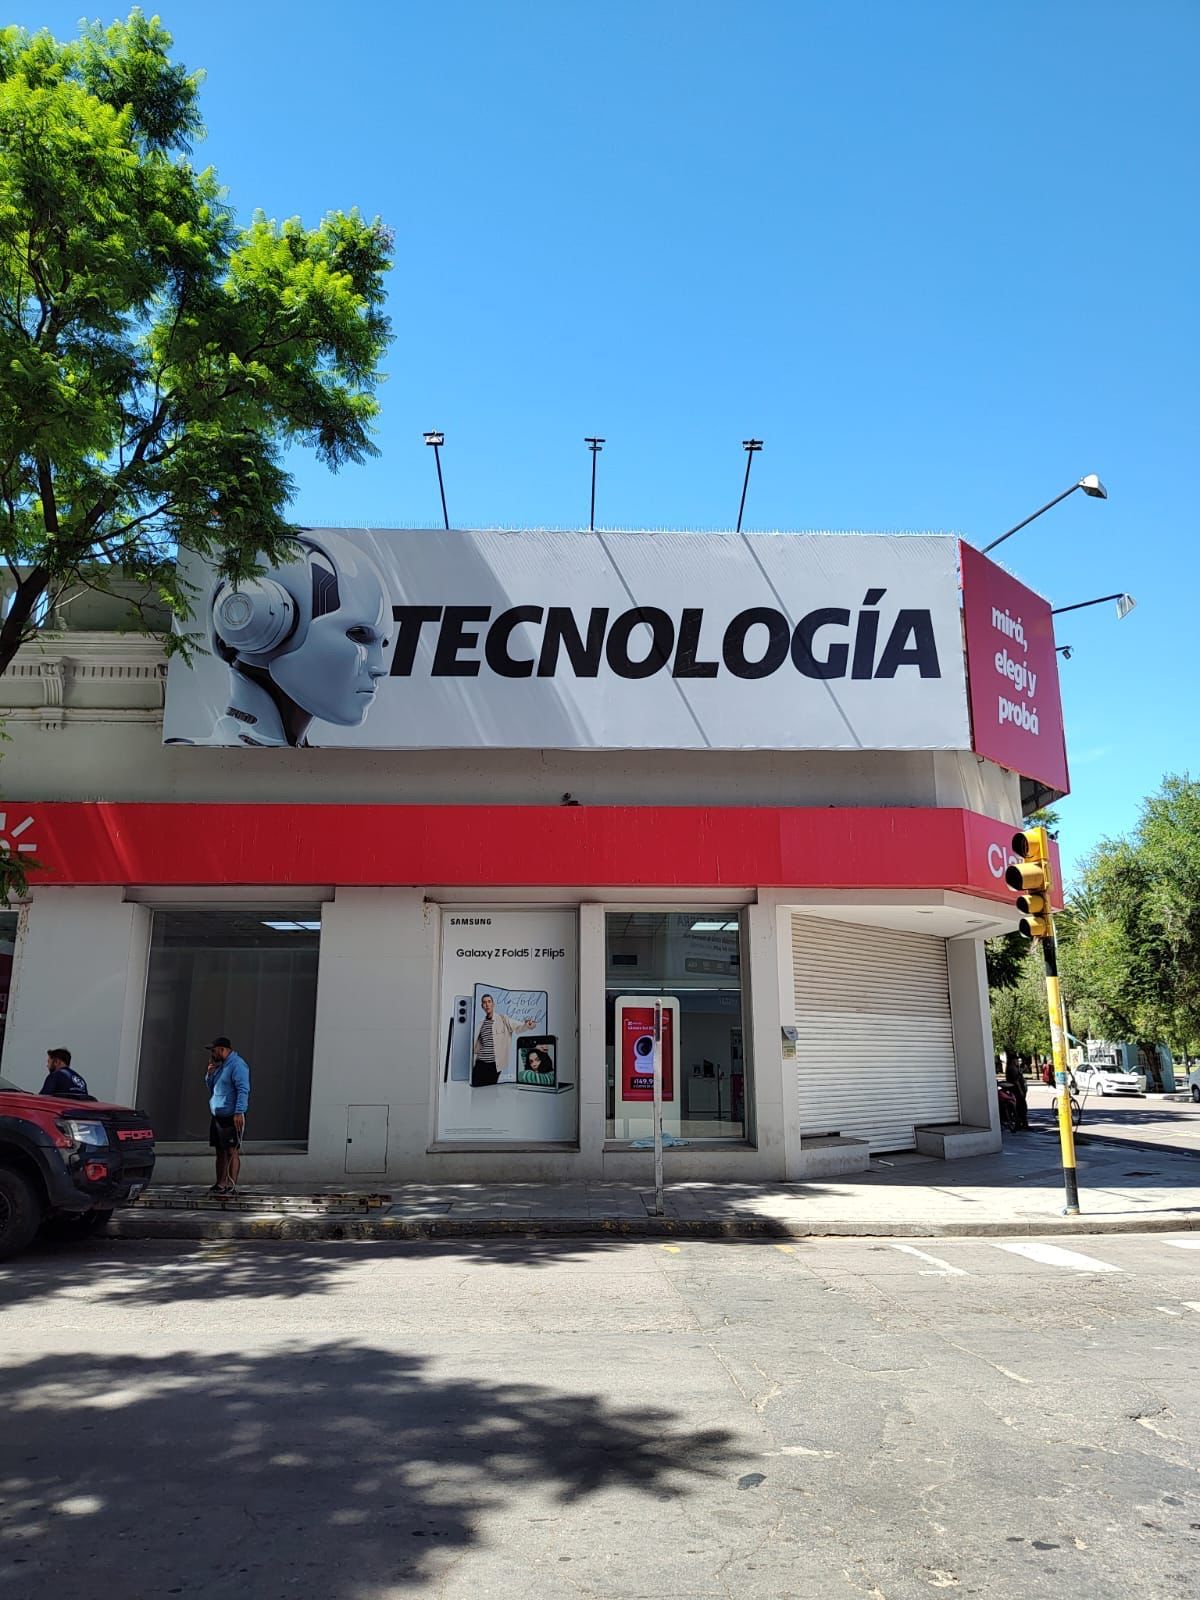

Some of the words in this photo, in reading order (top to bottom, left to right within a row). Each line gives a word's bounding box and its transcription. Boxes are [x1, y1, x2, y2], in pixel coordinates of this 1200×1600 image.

[389, 588, 941, 680] TECNOLOGÍA
[991, 606, 1028, 652] mirá,
[1027, 670, 1037, 698] y
[998, 695, 1039, 736] probá
[450, 918, 492, 926] SAMSUNG
[456, 948, 493, 959] Galaxy
[494, 949, 501, 958] Z
[502, 948, 529, 958] Fold5
[534, 949, 541, 958] Z
[542, 947, 565, 960] Flip5
